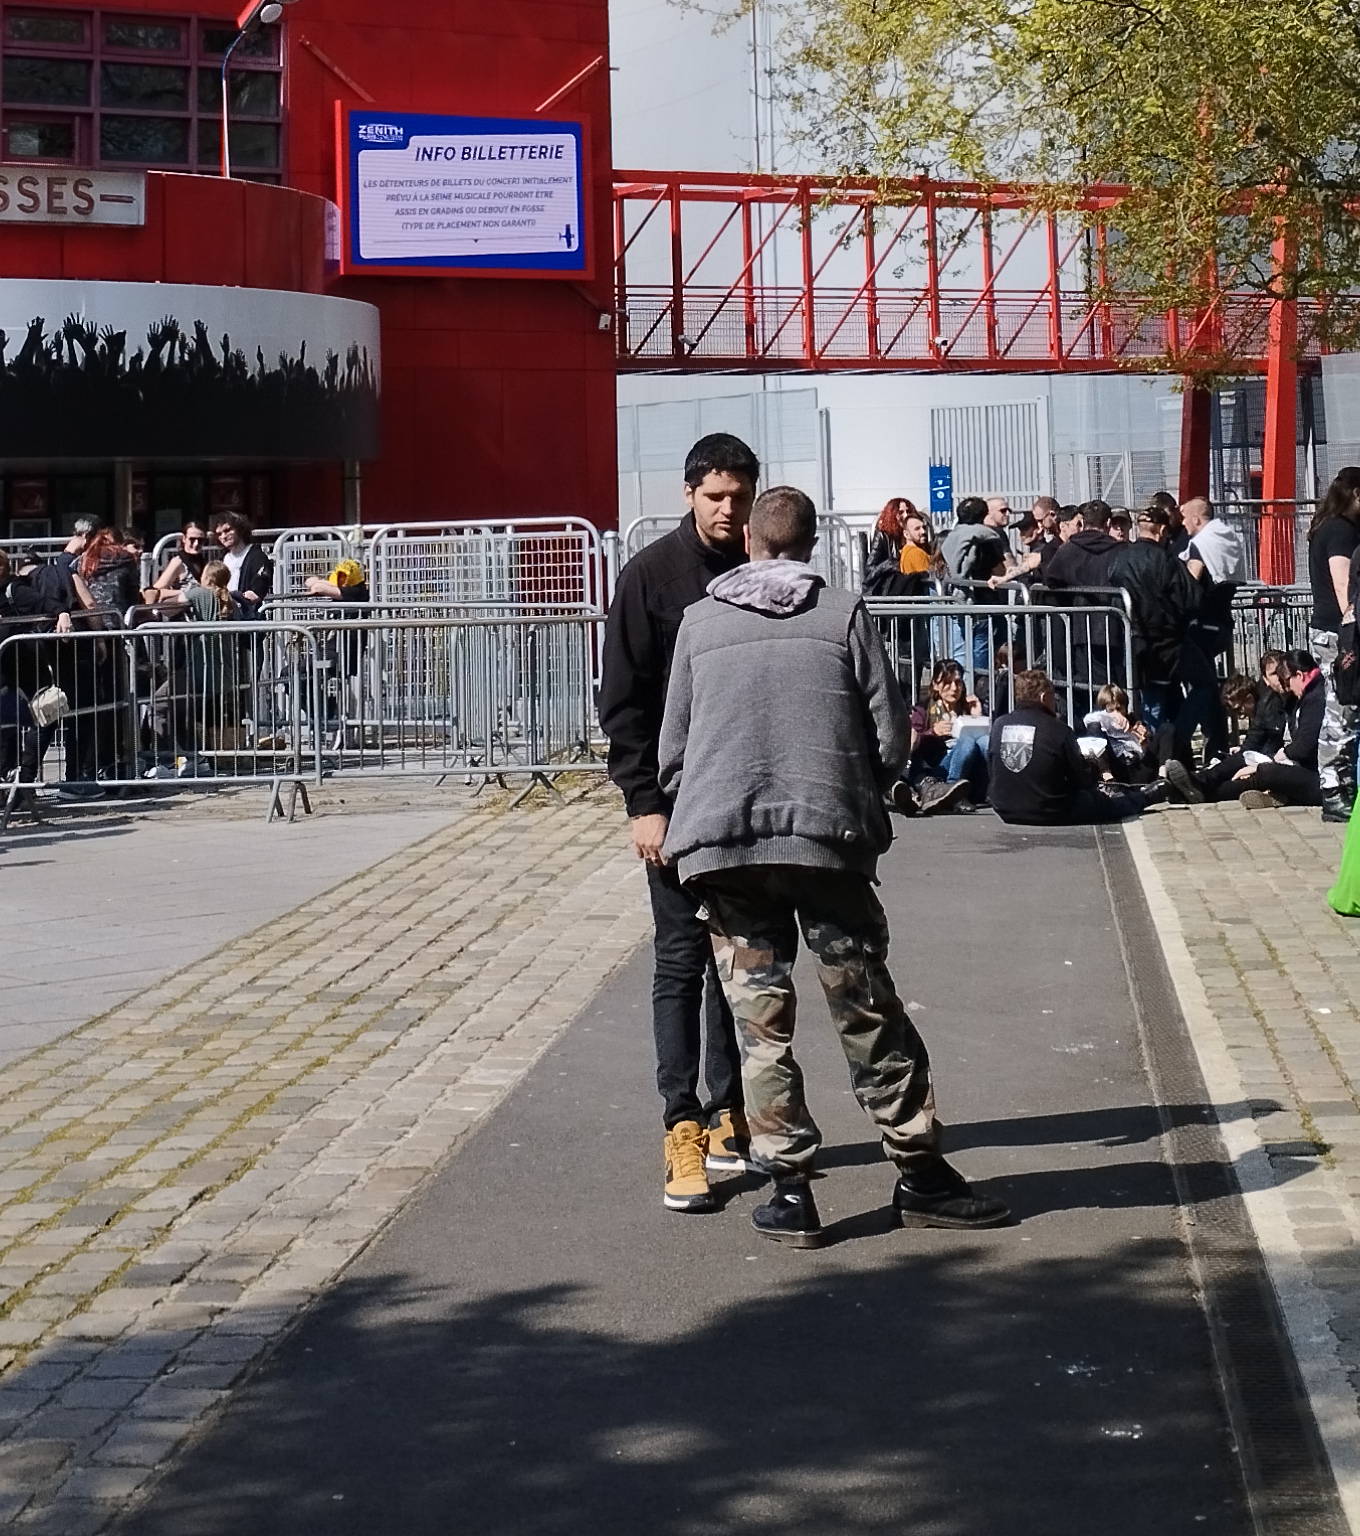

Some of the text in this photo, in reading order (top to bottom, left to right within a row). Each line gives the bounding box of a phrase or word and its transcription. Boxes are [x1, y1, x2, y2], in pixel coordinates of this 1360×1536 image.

[357, 124, 404, 135] ZENITH
[415, 145, 565, 162] INFO BILLETTERIE
[363, 180, 378, 188] LES
[430, 179, 441, 187] DE
[454, 192, 491, 200] MUSICALE
[394, 208, 417, 216] ASSIS
[430, 207, 464, 215] GRADINS
[465, 206, 476, 214] OU
[425, 222, 435, 230] DE
[436, 220, 481, 230] PLACEMENT
[34, 495, 44, 510] 4
